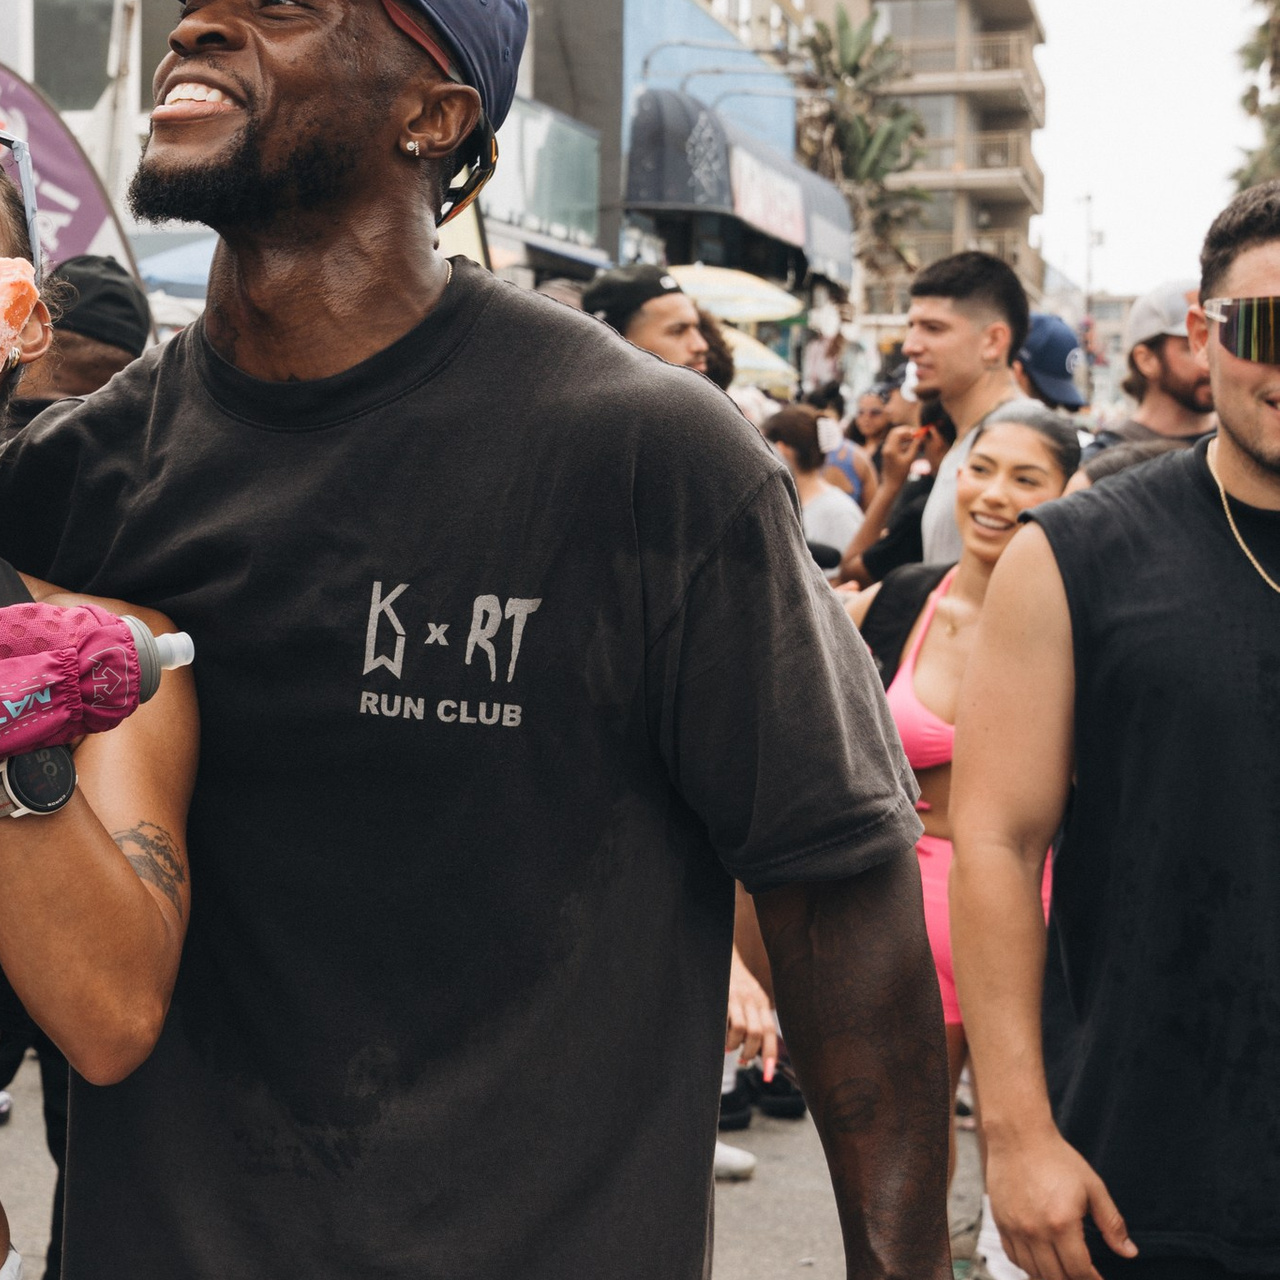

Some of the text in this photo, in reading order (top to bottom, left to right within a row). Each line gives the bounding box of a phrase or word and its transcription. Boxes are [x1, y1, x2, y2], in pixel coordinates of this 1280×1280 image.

[465, 593, 543, 683] RT
[359, 690, 523, 728] RUN CLUB
